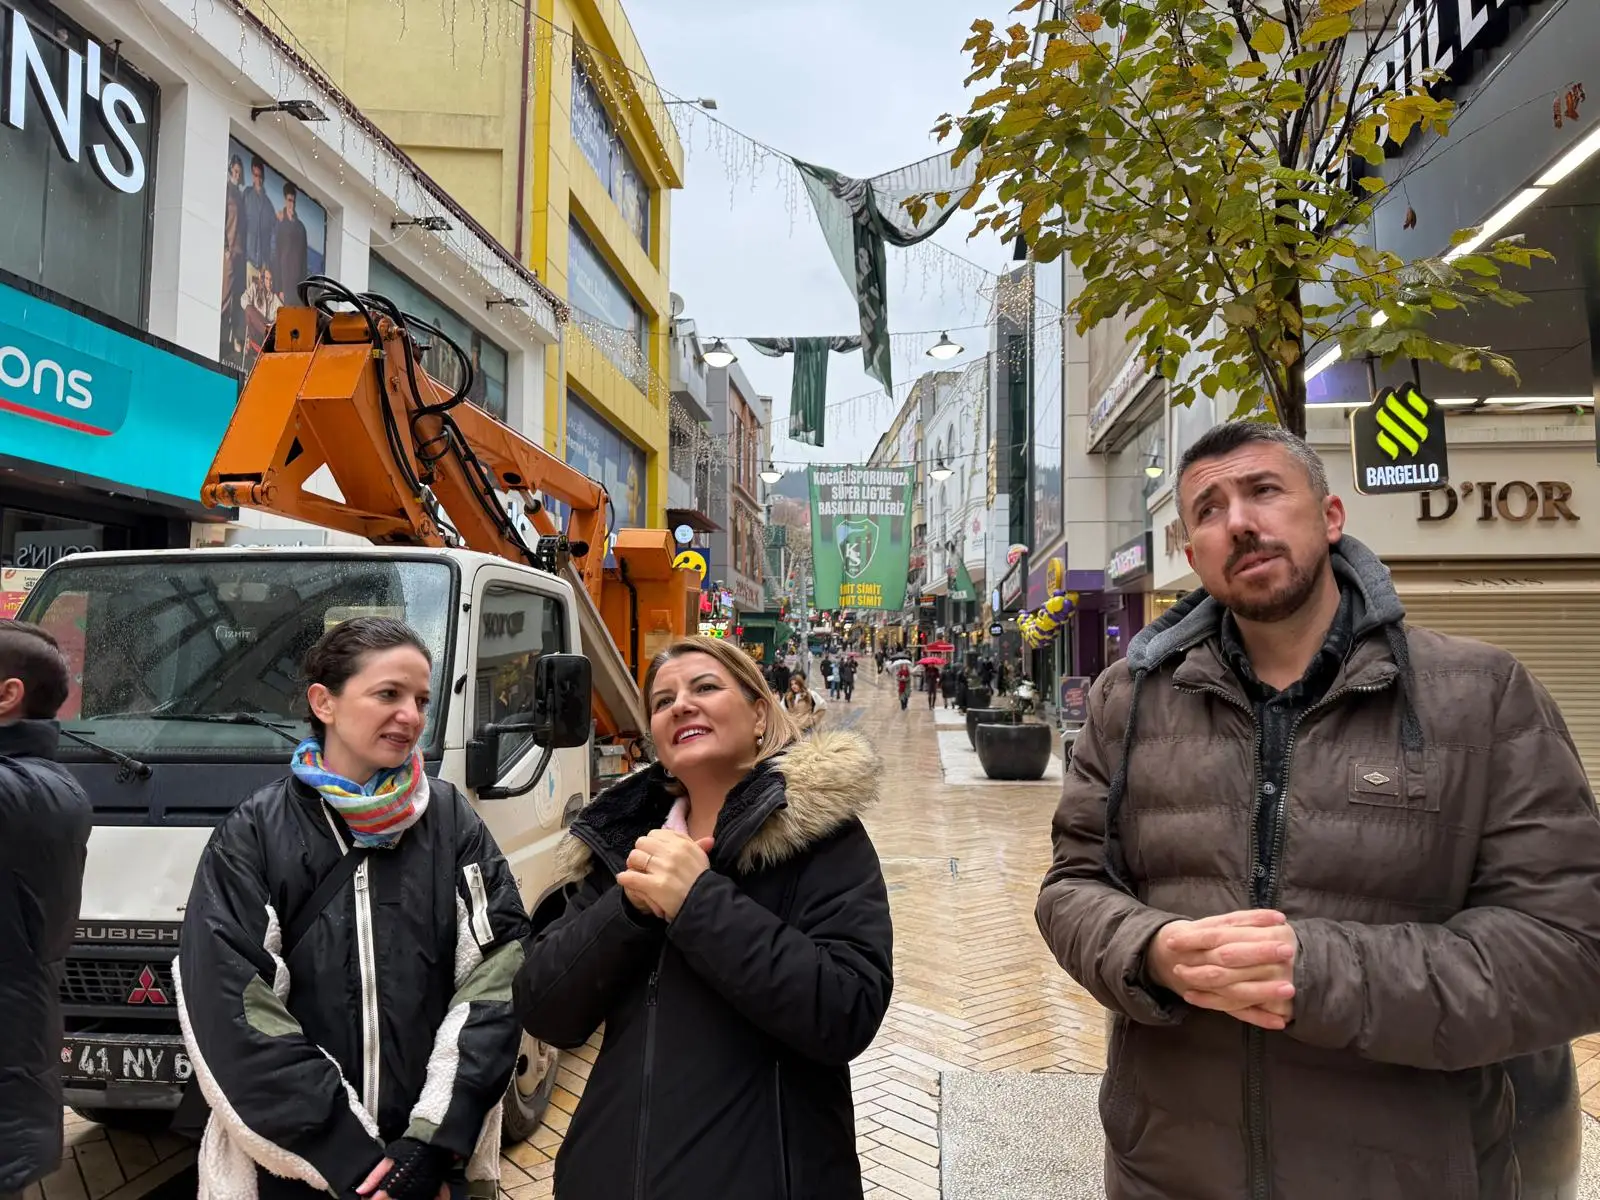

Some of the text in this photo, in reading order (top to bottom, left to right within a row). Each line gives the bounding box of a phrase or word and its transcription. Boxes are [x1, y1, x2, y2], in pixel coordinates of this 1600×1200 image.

[0, 346, 93, 409] ons
[1366, 463, 1439, 487] BARGELLO
[831, 484, 892, 500] SÜPER LİG'DE
[1417, 481, 1580, 521] D'IOR
[869, 499, 905, 515] DİLERİZ
[78, 1045, 193, 1079] 41 NY 6
